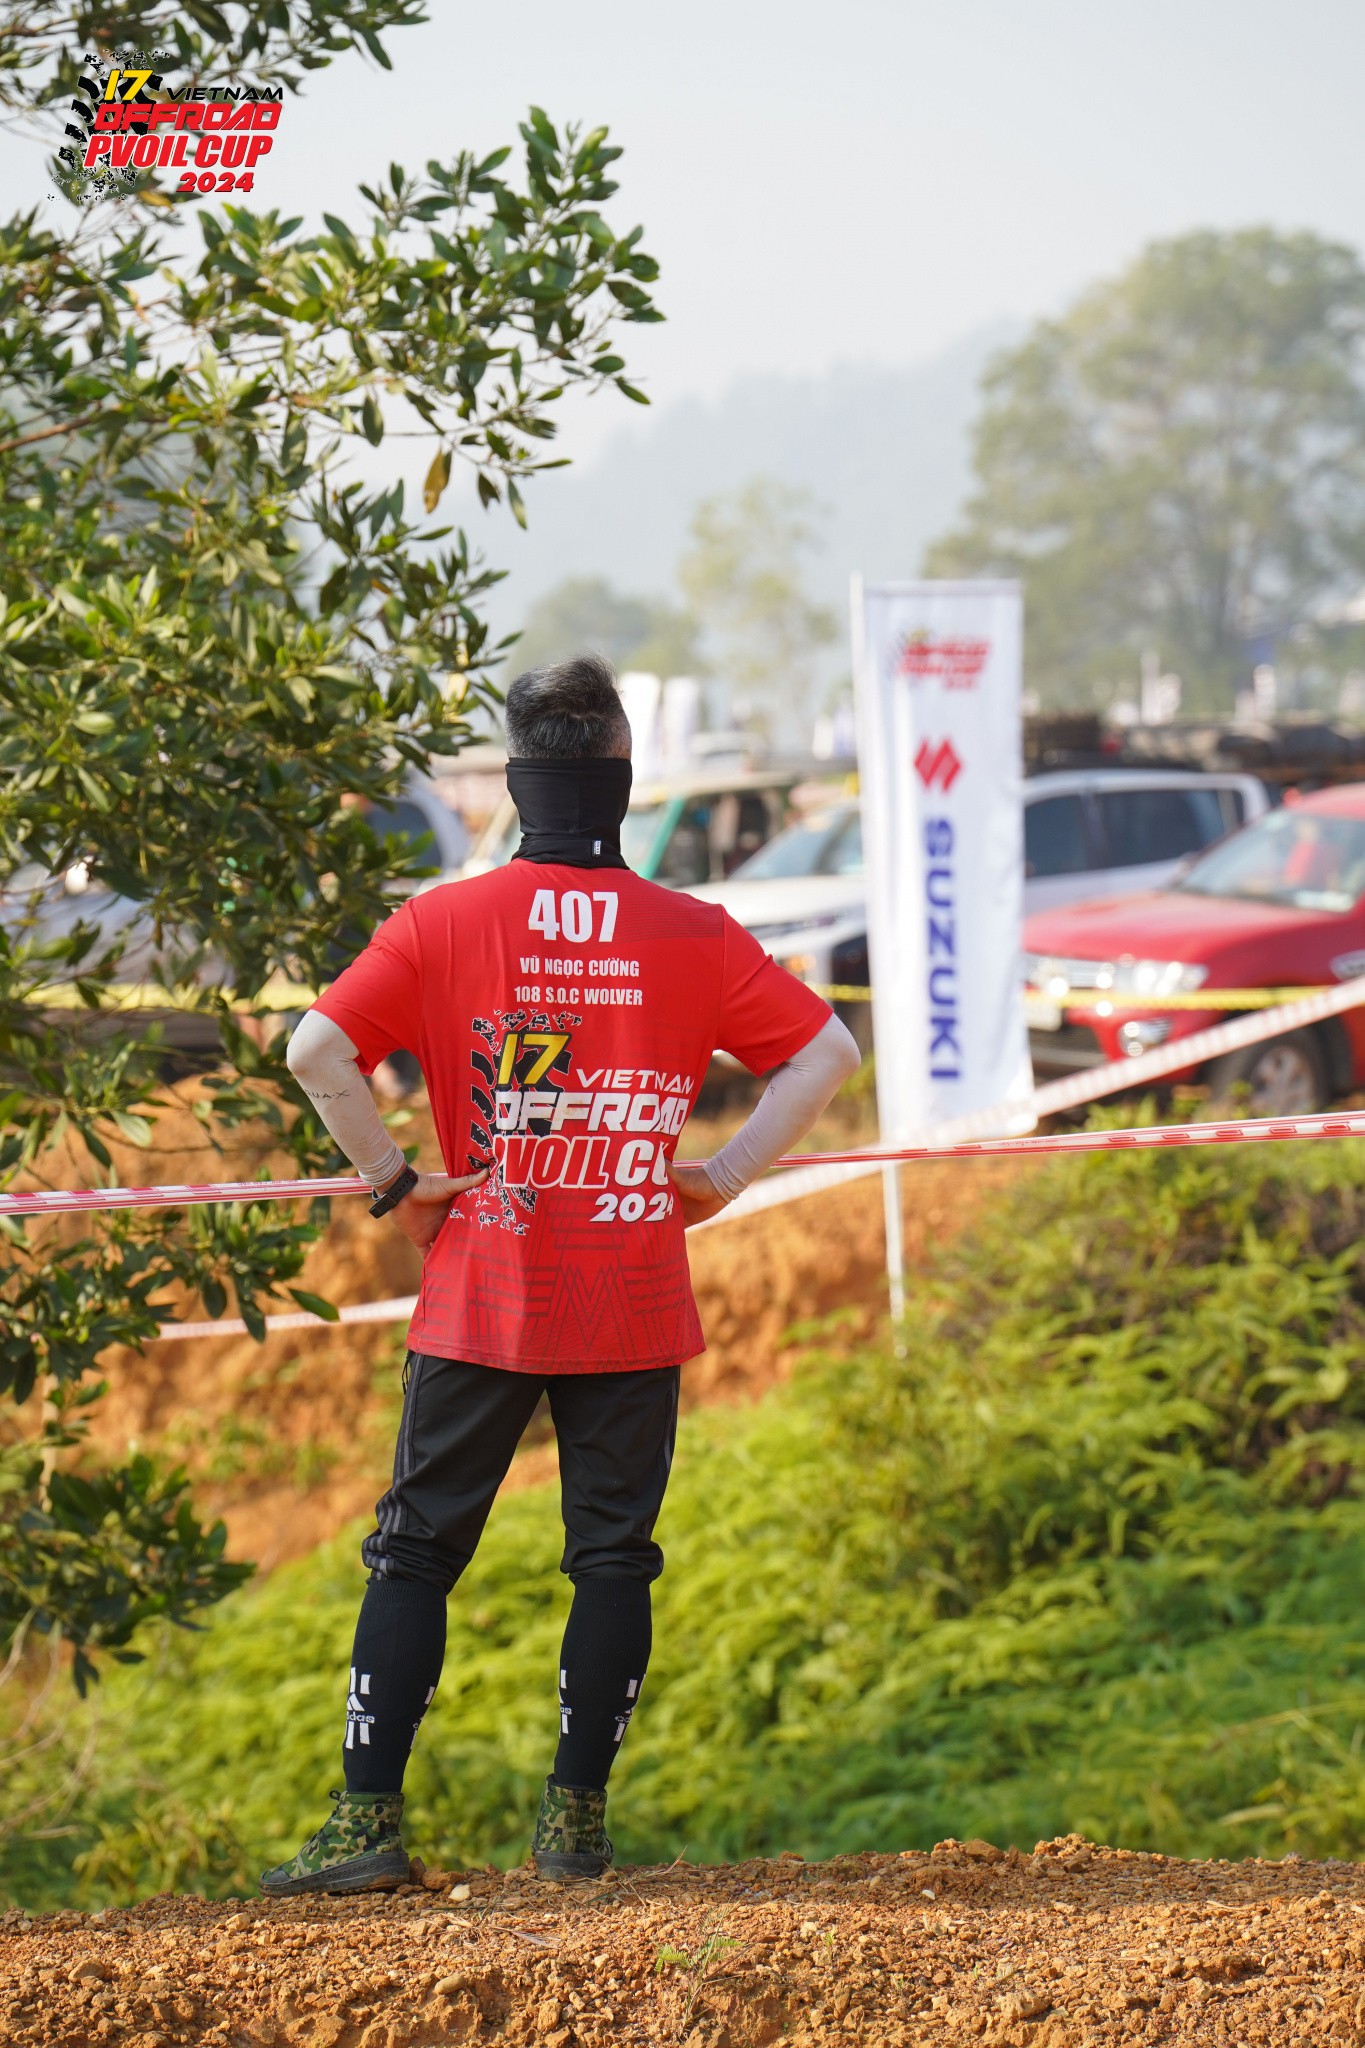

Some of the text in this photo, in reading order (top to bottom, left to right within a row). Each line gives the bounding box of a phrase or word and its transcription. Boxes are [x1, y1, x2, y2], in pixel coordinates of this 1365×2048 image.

[528, 889, 619, 943] 407
[519, 955, 640, 979] VŨ NGỌC CƯỜNG
[925, 818, 961, 1081] SUZUKI
[514, 986, 643, 1006] 108 S.O.C WOLVER
[497, 1032, 573, 1086] 17
